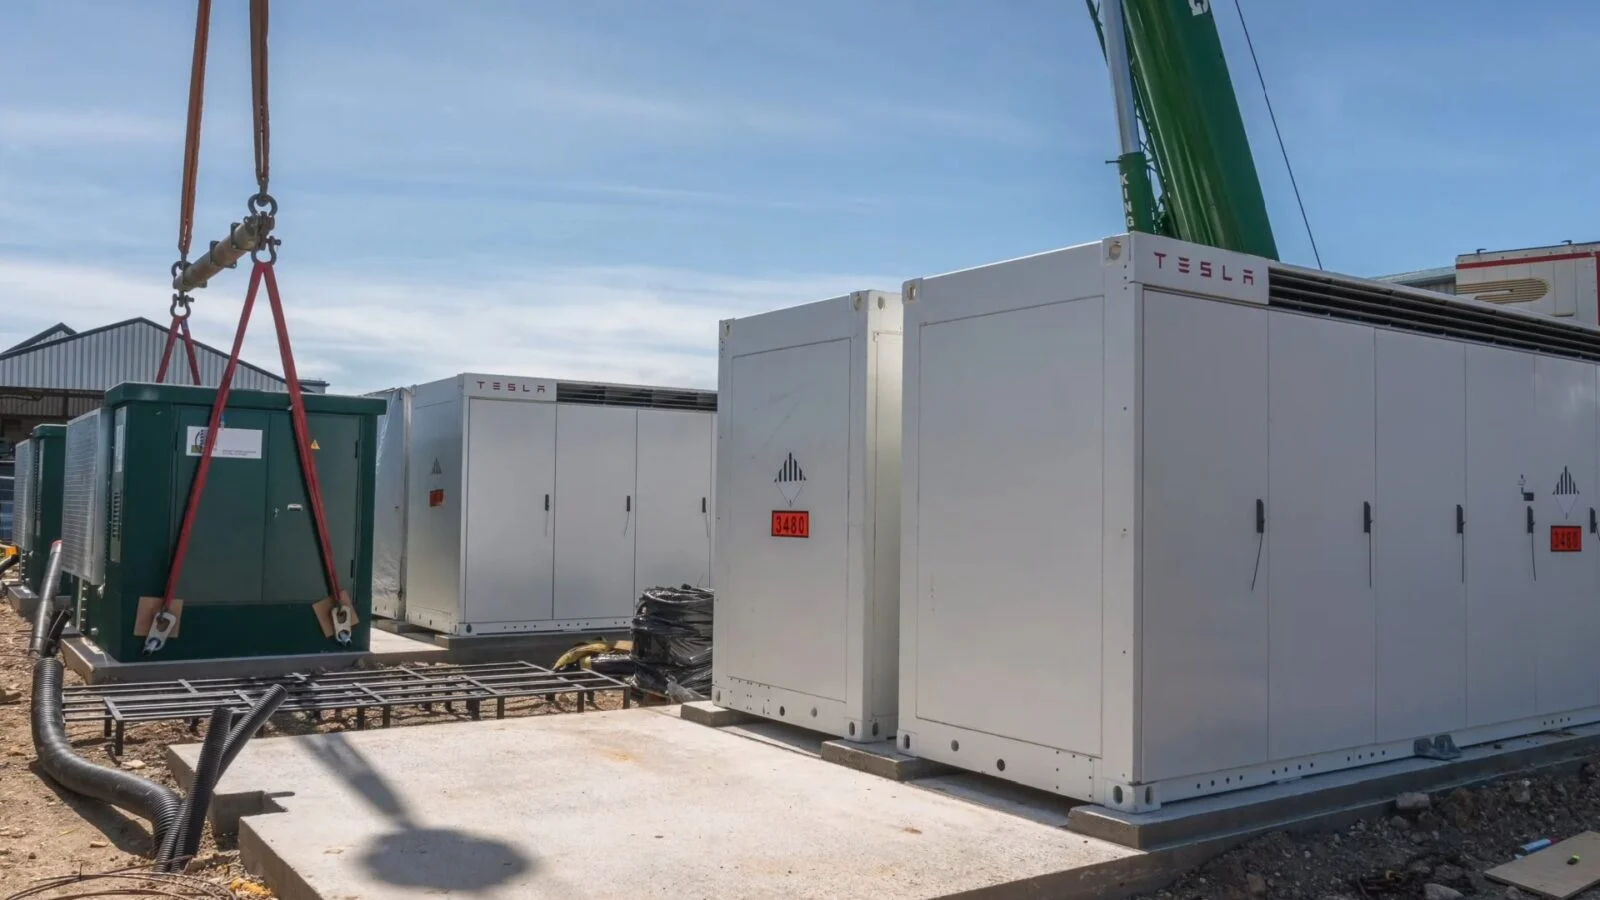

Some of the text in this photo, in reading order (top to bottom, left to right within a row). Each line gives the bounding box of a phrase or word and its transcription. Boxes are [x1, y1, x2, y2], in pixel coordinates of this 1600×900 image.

[1120, 173, 1135, 228] KING
[1153, 251, 1254, 286] TESLA
[476, 380, 546, 394] TESLA
[775, 515, 805, 534] 3480
